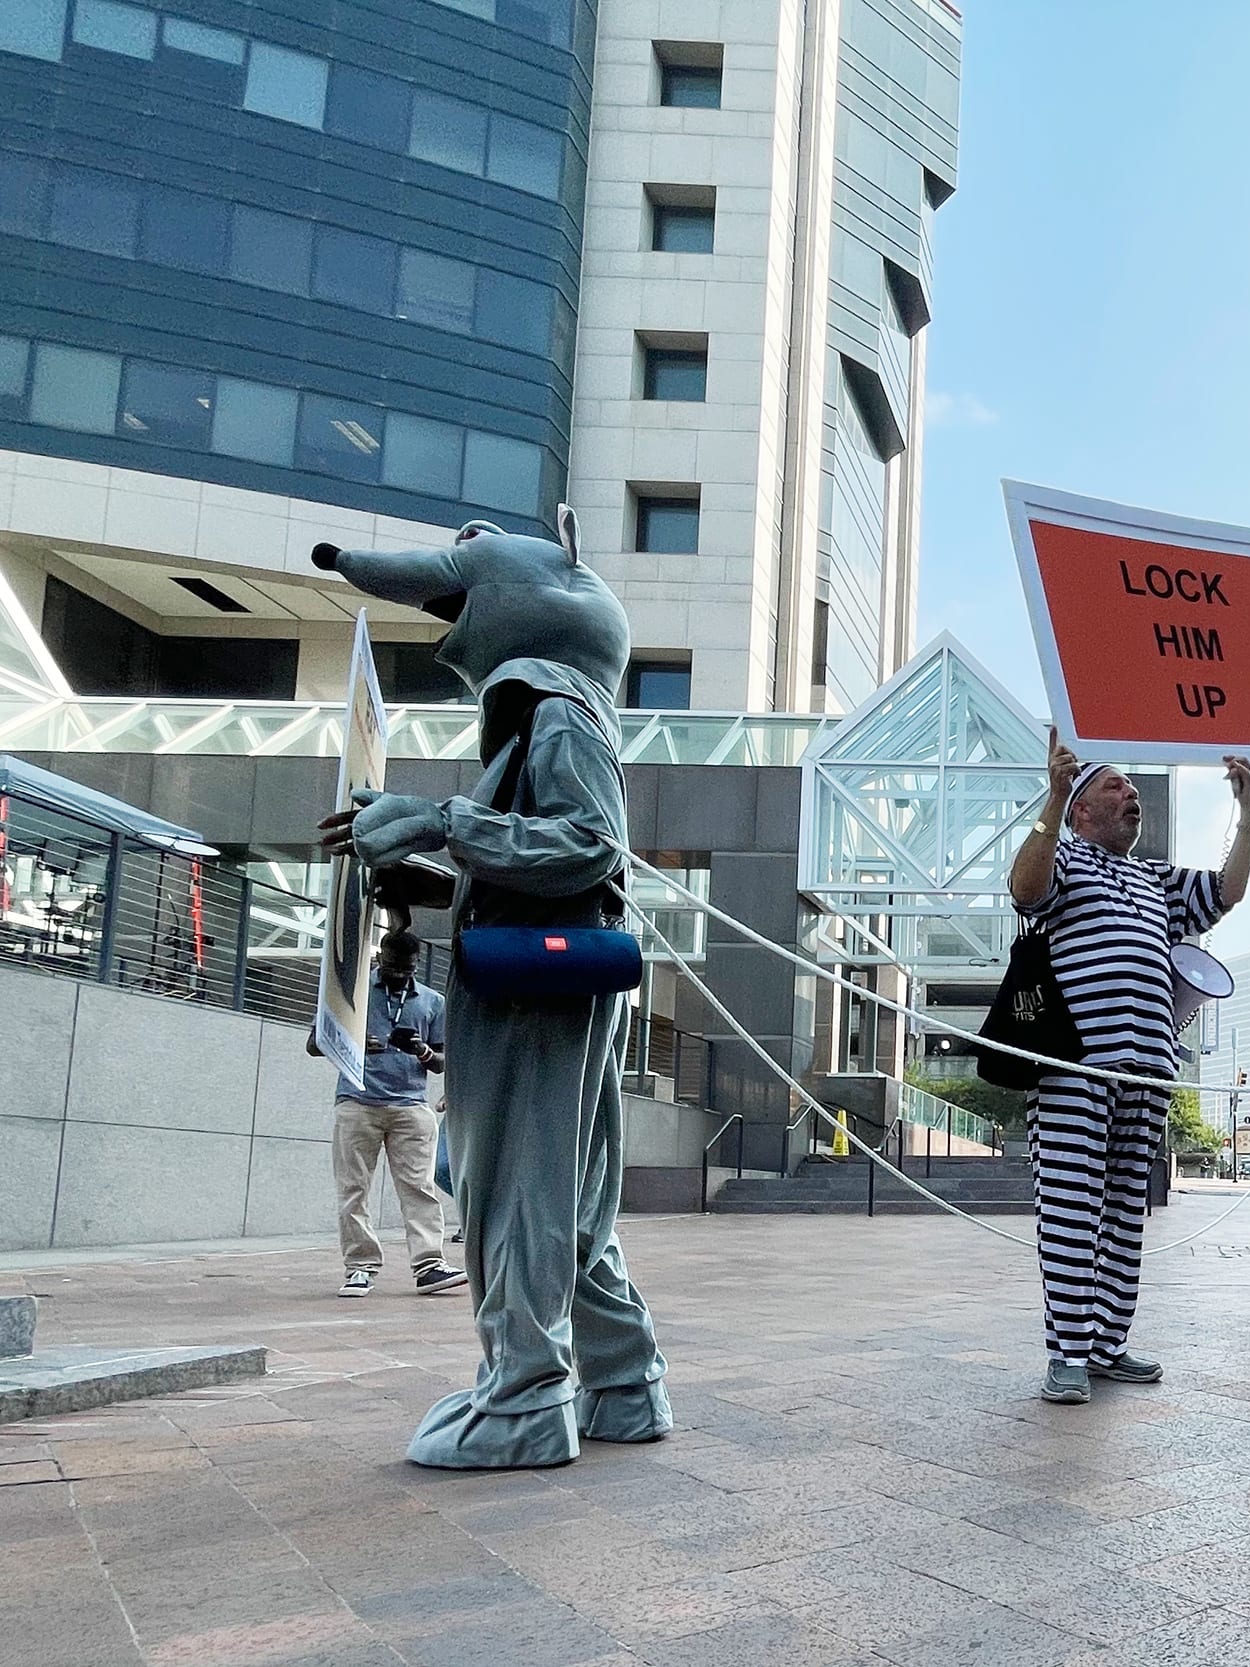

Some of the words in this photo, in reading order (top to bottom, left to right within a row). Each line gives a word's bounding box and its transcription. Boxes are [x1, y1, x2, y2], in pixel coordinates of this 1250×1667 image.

[1119, 560, 1230, 607] LOCK
[1153, 623, 1225, 662] HIM
[1176, 683, 1227, 719] UP
